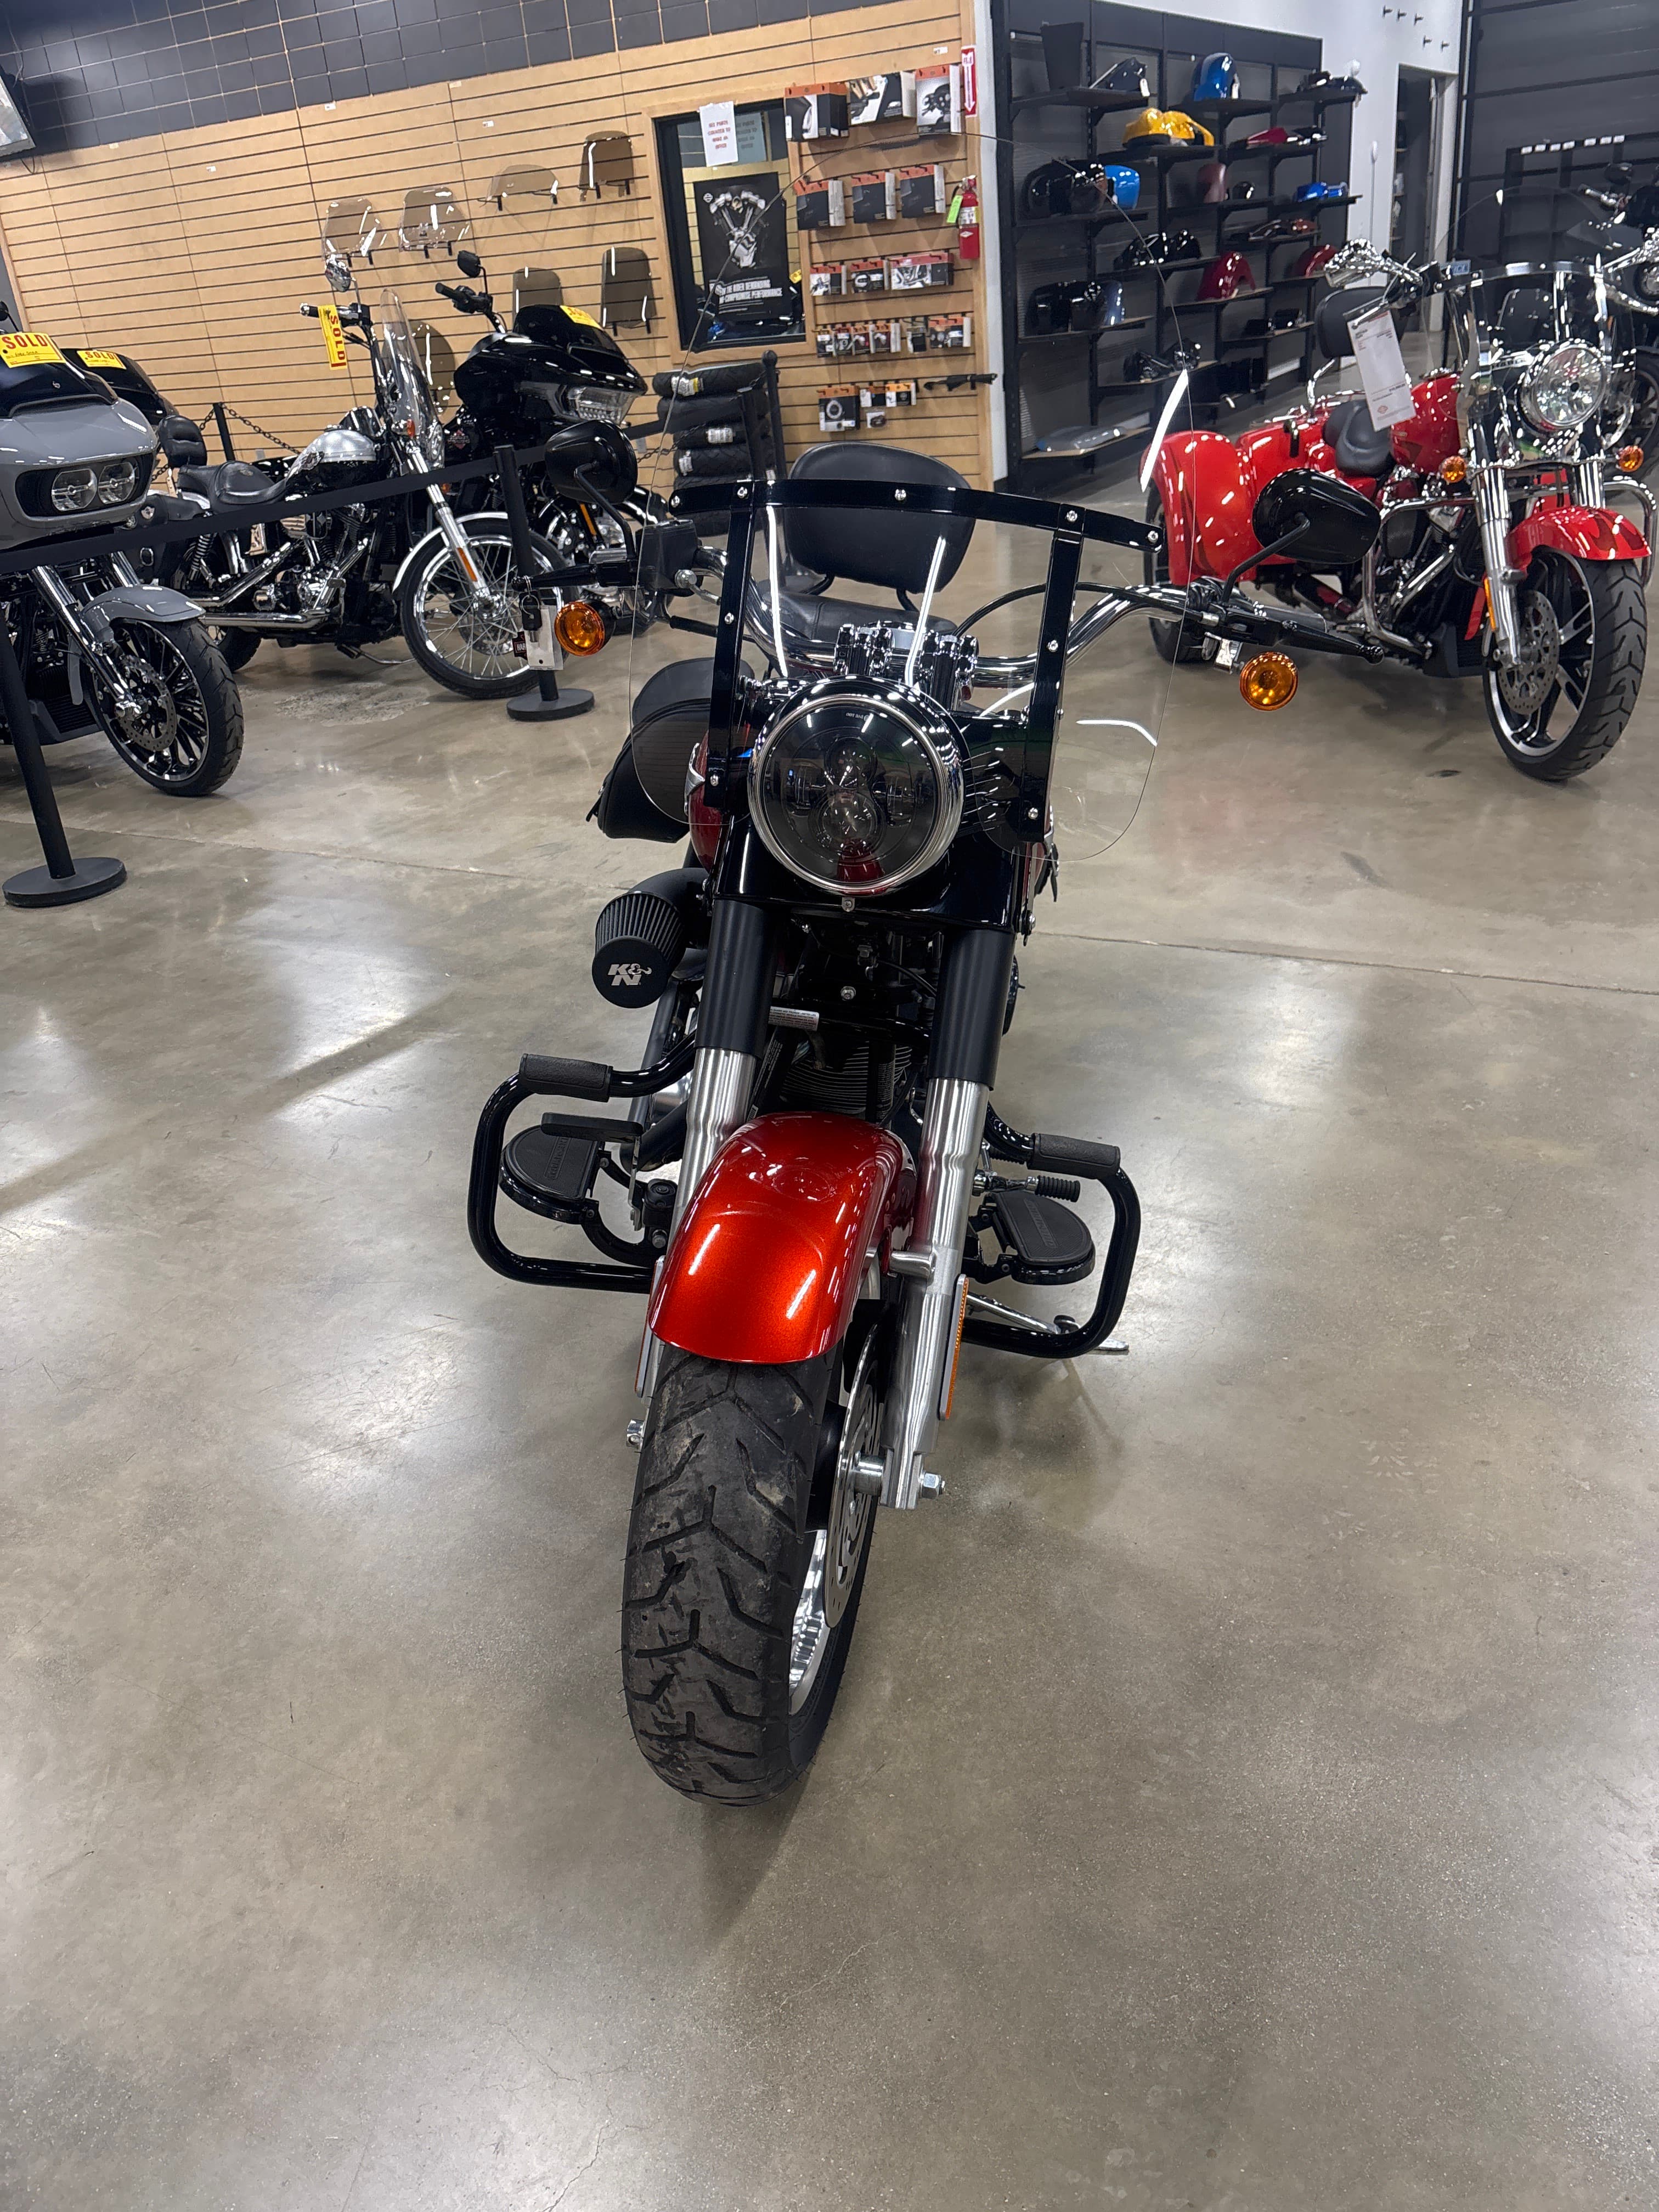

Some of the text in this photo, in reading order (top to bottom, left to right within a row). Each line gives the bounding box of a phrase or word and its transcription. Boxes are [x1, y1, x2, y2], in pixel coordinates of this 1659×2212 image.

[2, 334, 48, 349] SOLD
[330, 315, 345, 360] SOLD
[85, 352, 115, 360] SOLD
[517, 642, 527, 651] HAR
